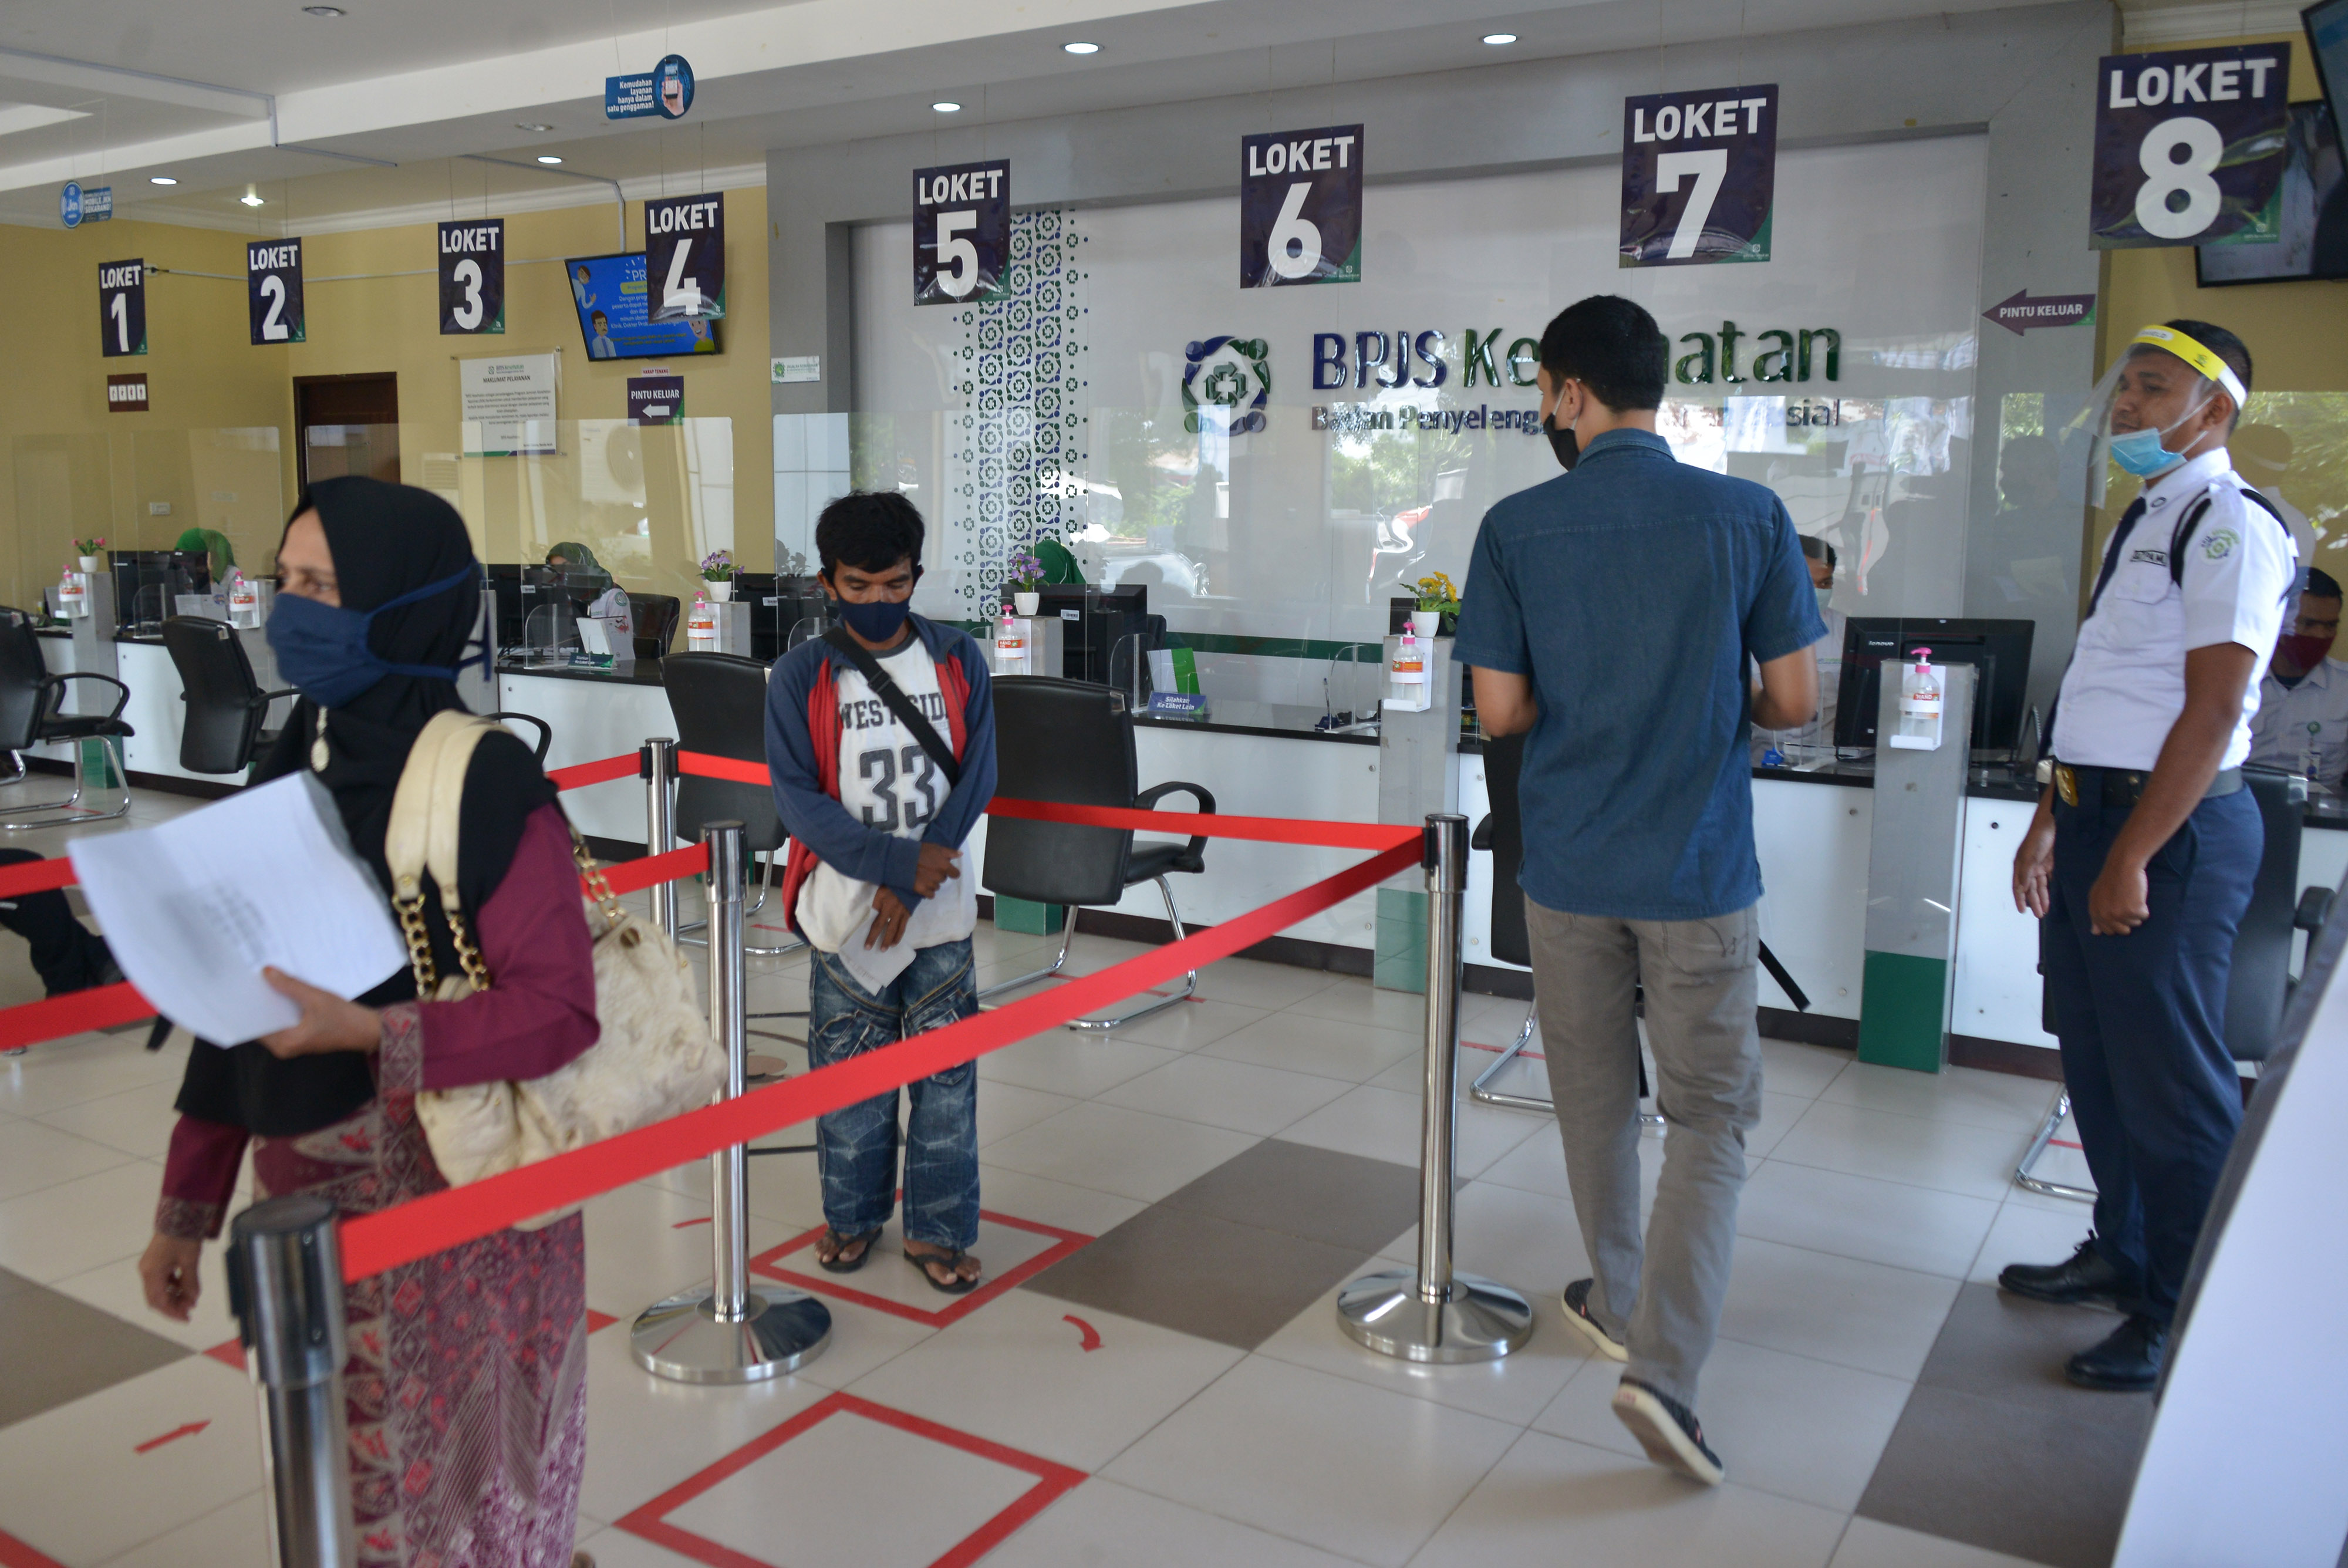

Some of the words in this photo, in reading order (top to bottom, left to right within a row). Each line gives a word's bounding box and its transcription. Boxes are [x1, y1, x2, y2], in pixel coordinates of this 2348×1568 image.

[618, 96, 635, 104] hanya
[635, 93, 653, 102] dalam
[619, 79, 653, 89] Kemudahan
[630, 87, 653, 96] layanan
[2109, 59, 2278, 109] LOKET
[607, 104, 619, 113] satu
[620, 100, 654, 113] genggaman!
[1634, 97, 1767, 143] LOKET
[1249, 136, 1355, 177] LOKET
[919, 169, 1003, 205] LOKET
[2135, 117, 2223, 239] 8
[649, 201, 718, 234] LOKET
[1656, 149, 1728, 259] 7
[441, 227, 499, 253] LOKET
[1267, 182, 1322, 279] 6
[249, 245, 298, 271] LOKET
[936, 209, 980, 298] 5
[100, 265, 141, 289] LOKET
[632, 269, 647, 281] PR
[663, 238, 701, 316] 4
[261, 275, 288, 340] 2
[453, 259, 483, 330] 3
[1999, 306, 2035, 318] PINTU
[2037, 304, 2083, 316] KELUAR
[111, 292, 130, 352] 1
[1313, 329, 1448, 389] BPJS
[1463, 321, 1841, 388] Keatan
[631, 390, 652, 399] PINTU
[653, 389, 680, 399] KELUAR
[1399, 404, 1547, 436] Penyeleng
[859, 745, 936, 834] 33
